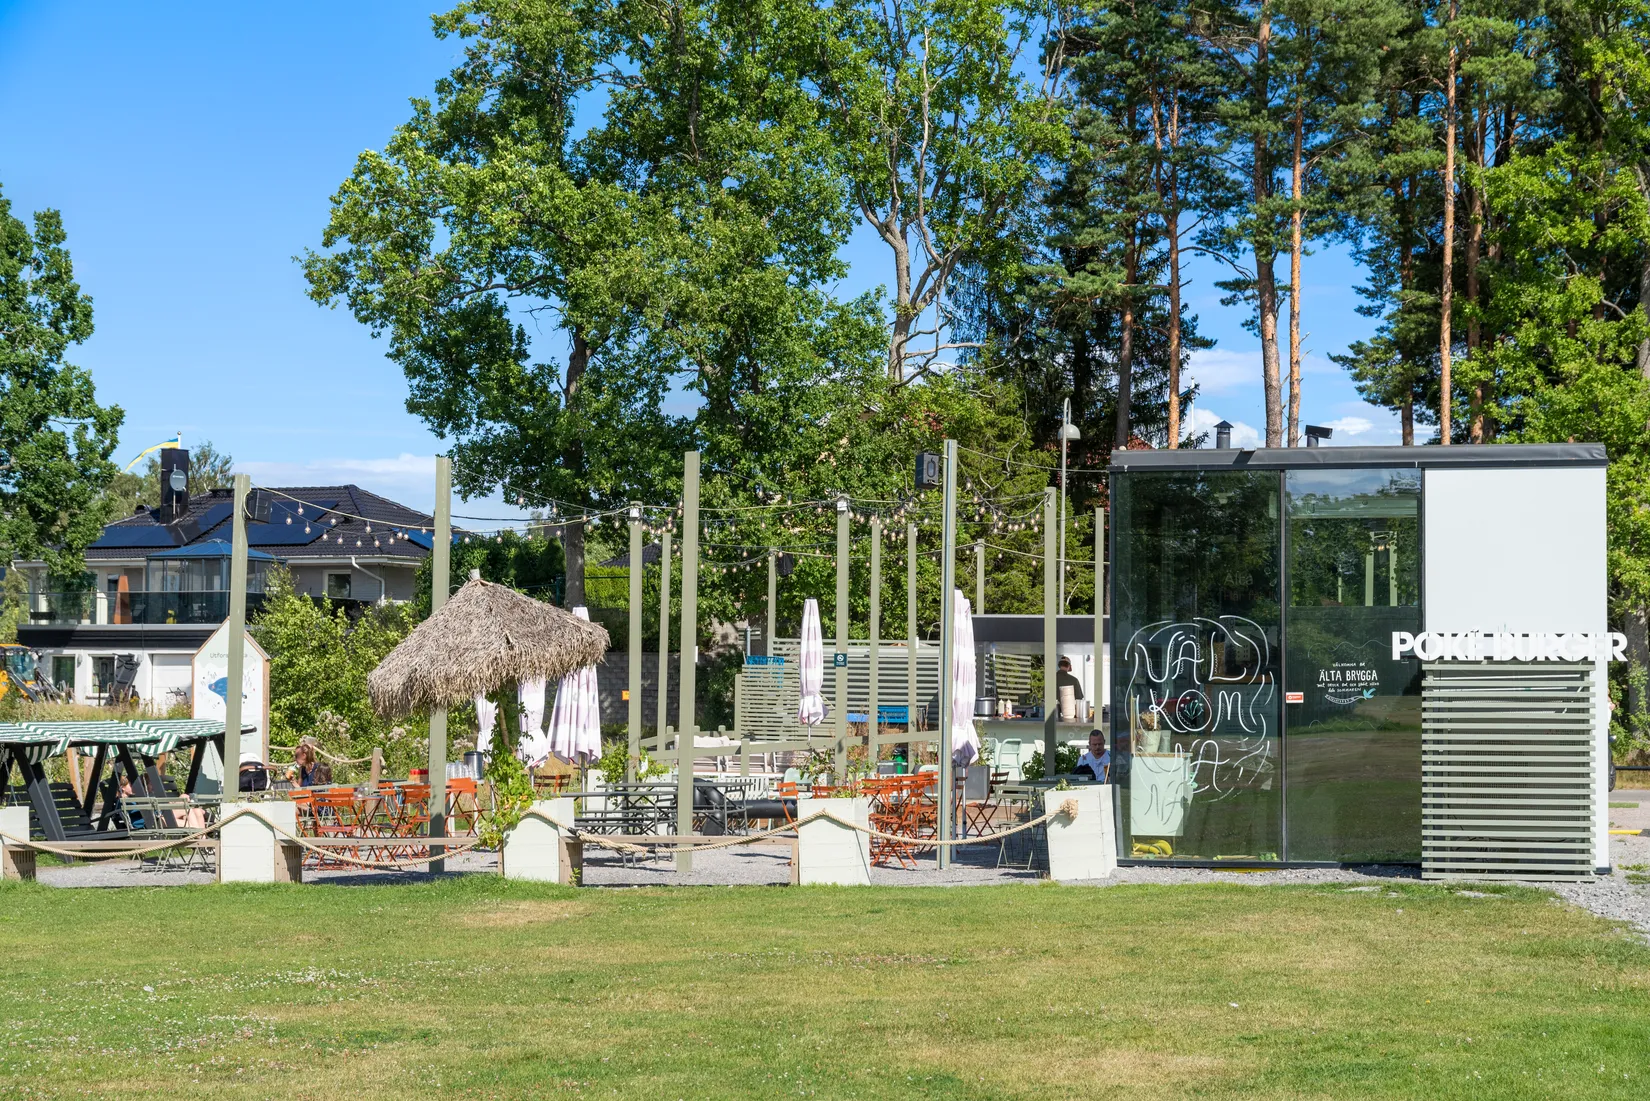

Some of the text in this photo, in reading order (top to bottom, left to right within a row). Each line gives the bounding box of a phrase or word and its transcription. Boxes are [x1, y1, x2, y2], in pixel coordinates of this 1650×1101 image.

[1493, 631, 1628, 662] BURGER
[1319, 669, 1378, 681] ÄLTA BRYGGA
